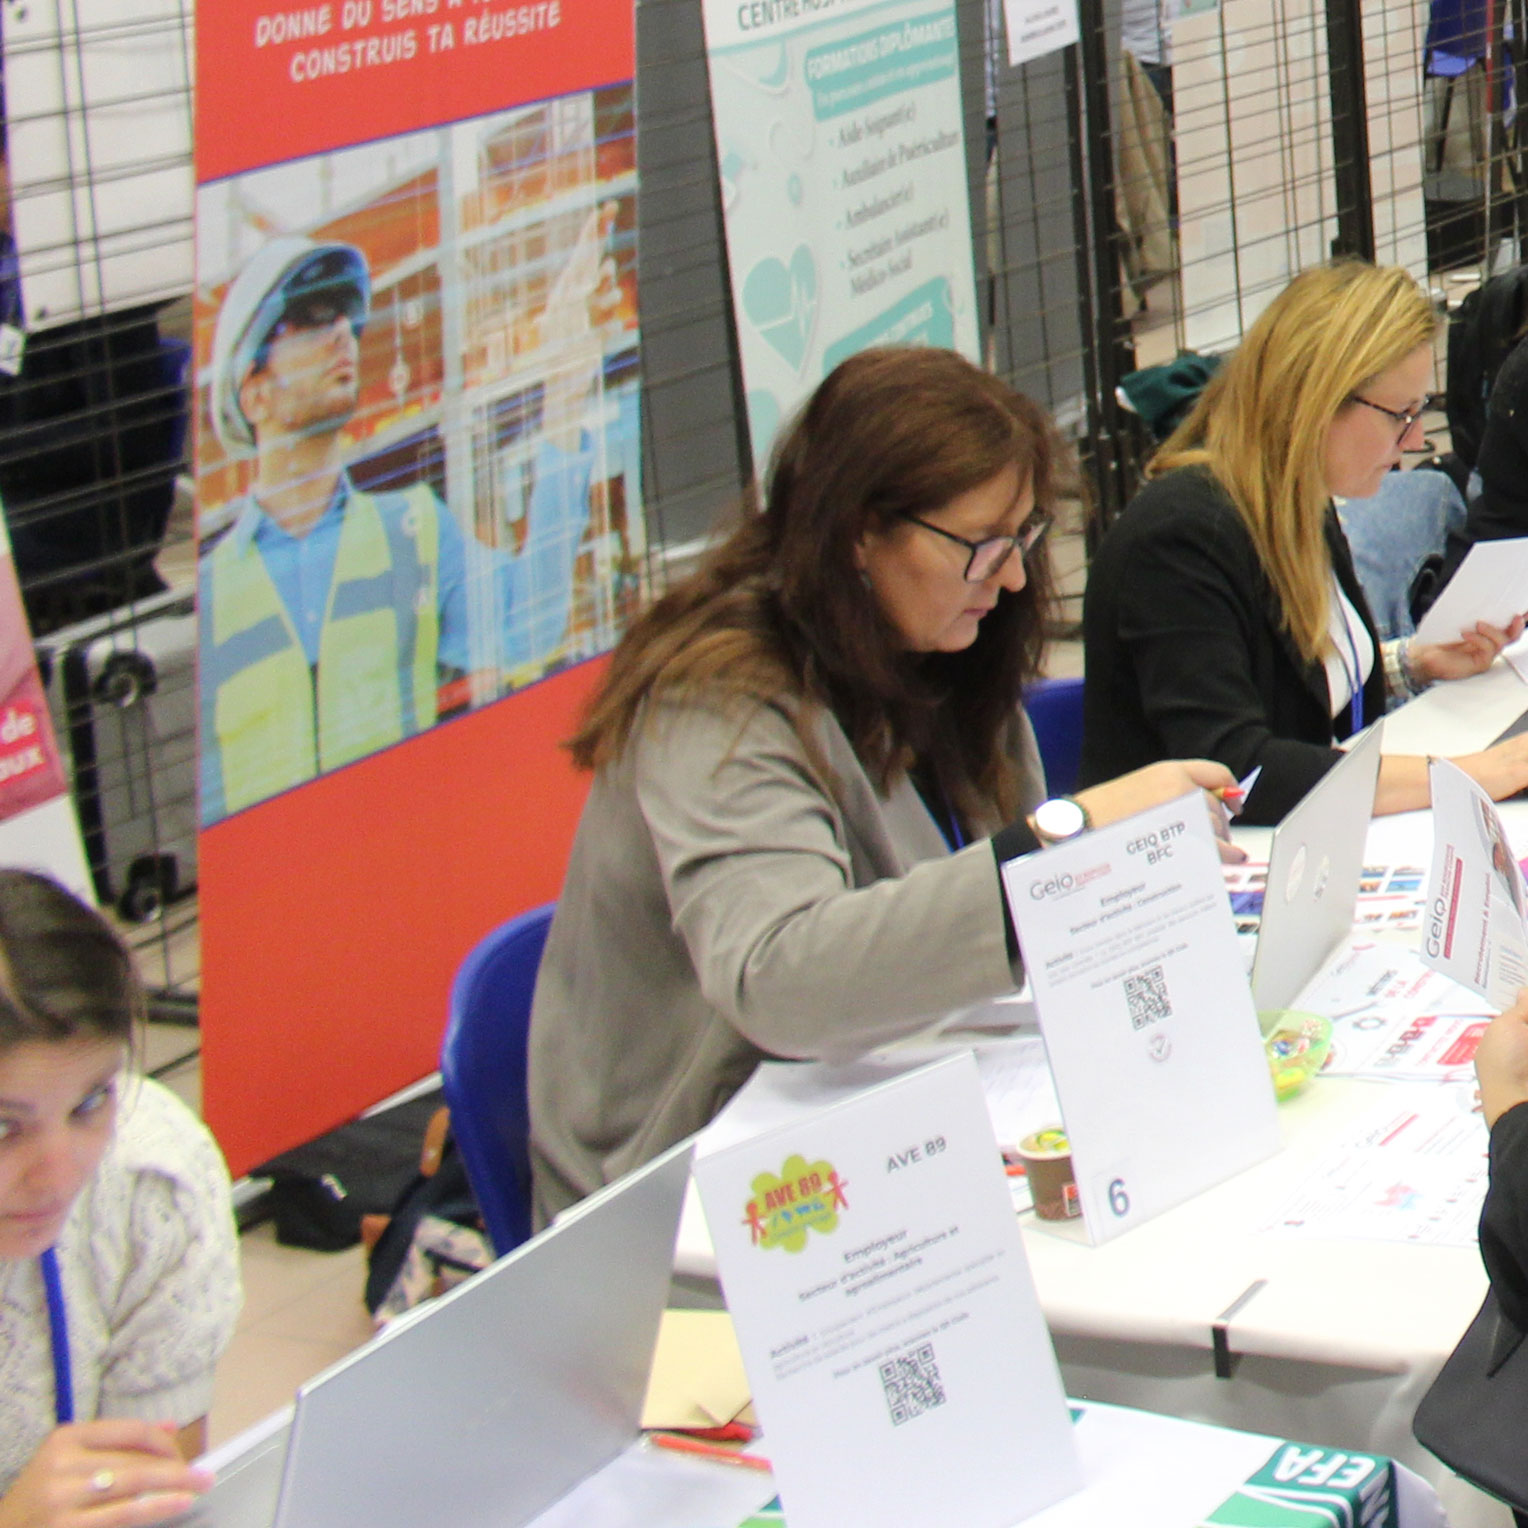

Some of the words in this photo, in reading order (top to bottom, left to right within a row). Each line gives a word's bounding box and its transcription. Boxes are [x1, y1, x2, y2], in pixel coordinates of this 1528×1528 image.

[254, 3, 332, 49] DONNE
[290, 30, 418, 84] CONSTRUIS
[427, 20, 456, 54] TA
[1125, 835, 1159, 856] GEIQ
[1159, 821, 1187, 843] BTP
[1146, 845, 1175, 866] BFC
[885, 1147, 922, 1174] AVE
[925, 1136, 947, 1156] 89
[1108, 1177, 1131, 1218] 6
[843, 1229, 908, 1264] Employeur
[1272, 1445, 1377, 1490] EFA
